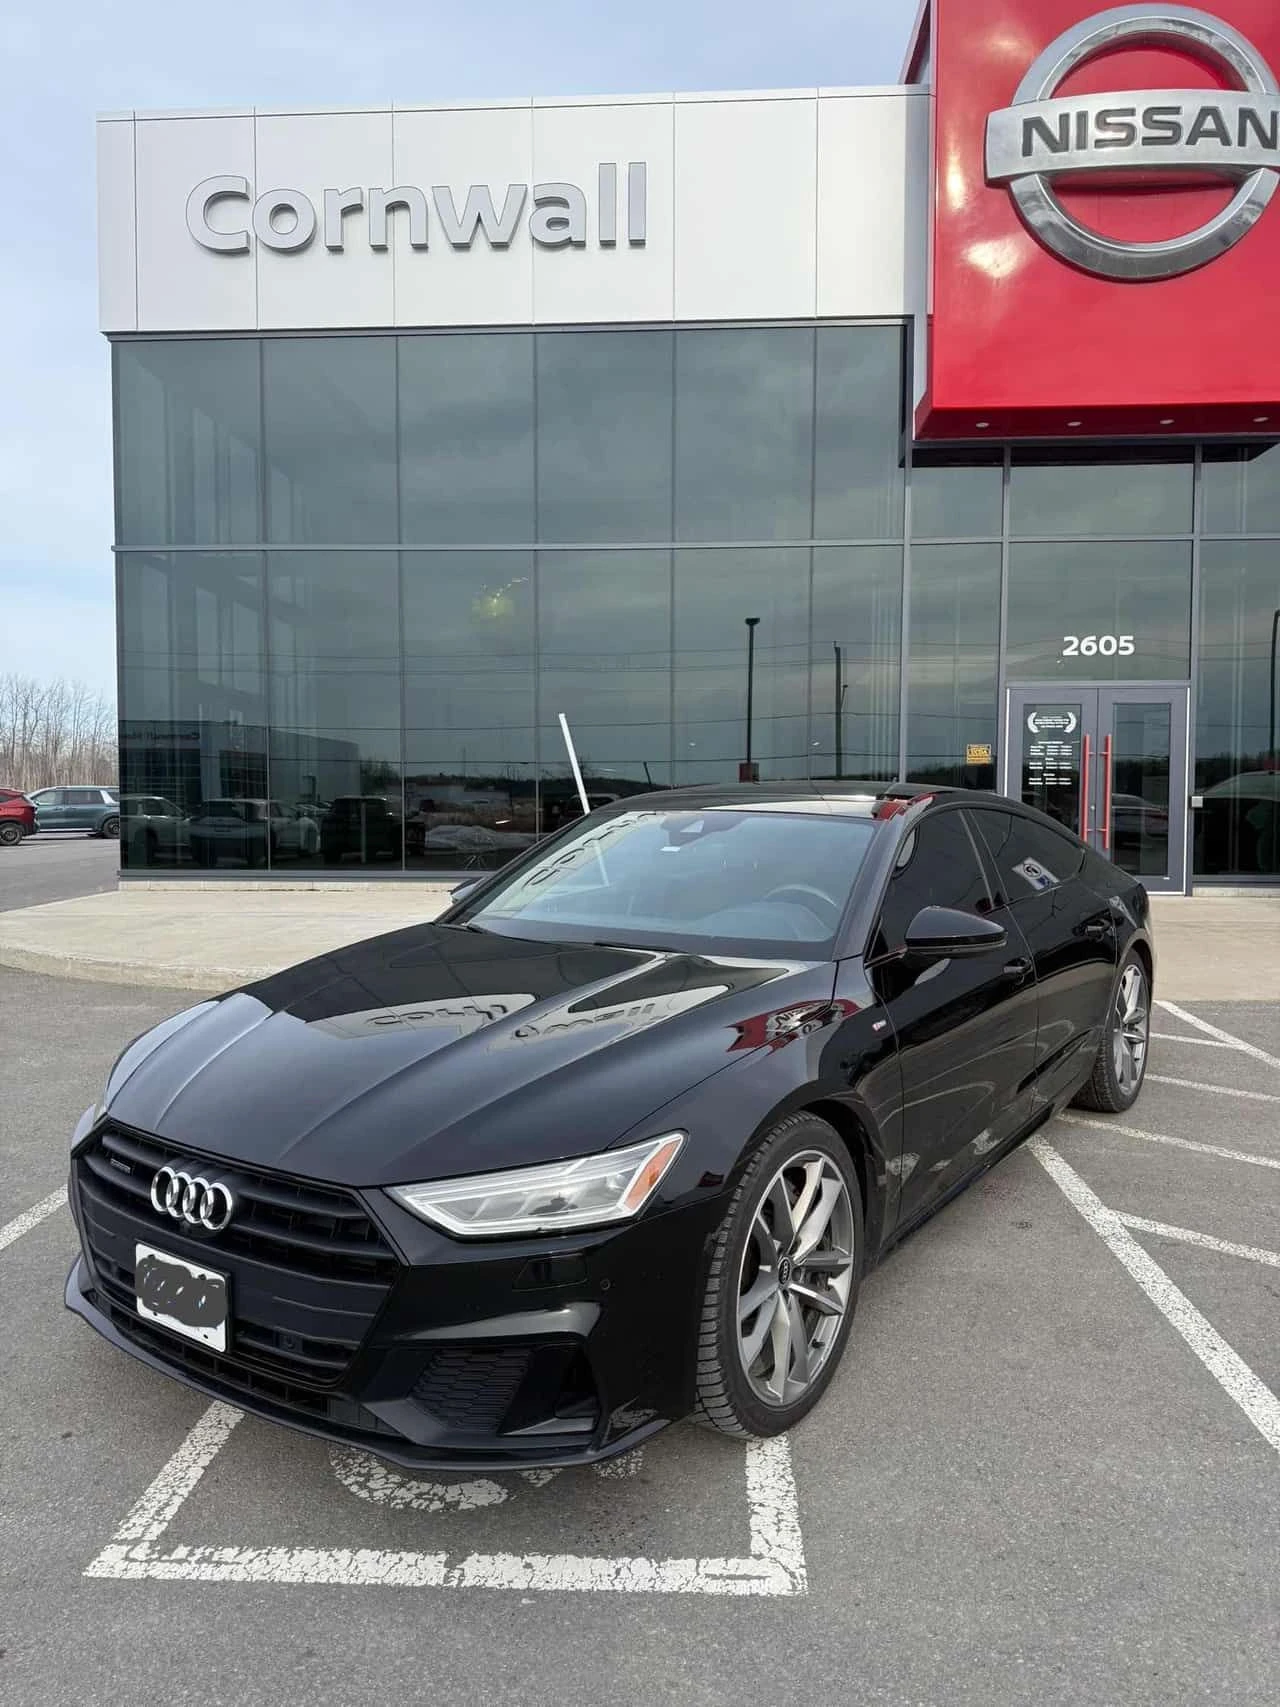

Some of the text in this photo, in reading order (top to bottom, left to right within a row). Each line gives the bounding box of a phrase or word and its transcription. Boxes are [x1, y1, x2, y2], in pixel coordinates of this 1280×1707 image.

[1022, 106, 1279, 157] NISSAN
[186, 162, 647, 253] Cornwall
[1062, 635, 1135, 656] 2605
